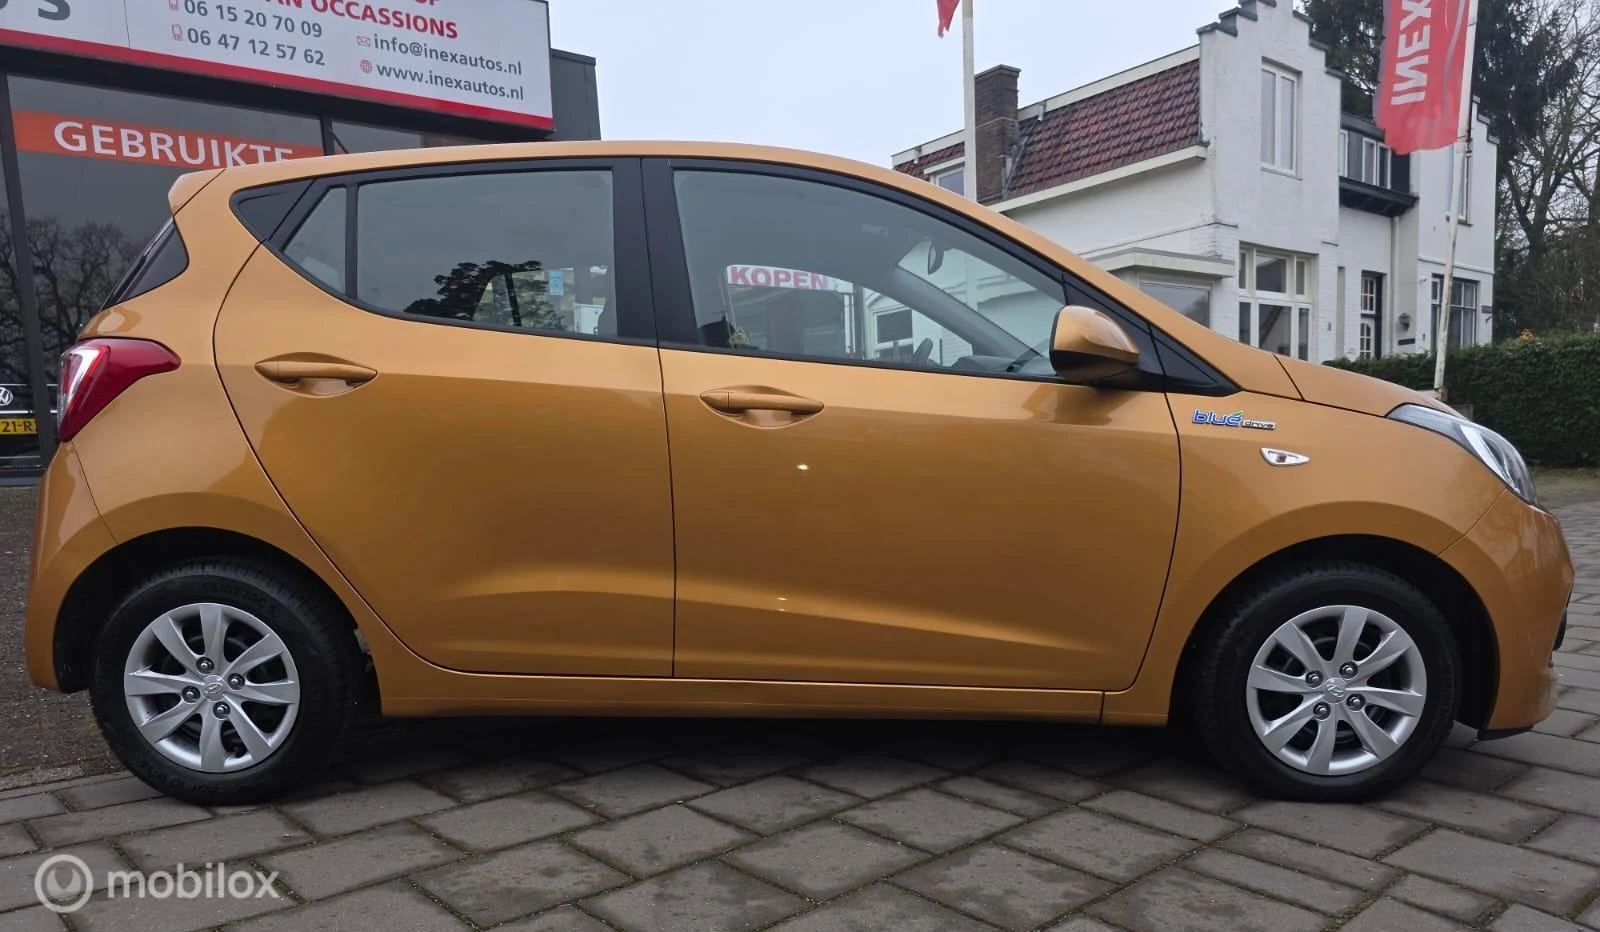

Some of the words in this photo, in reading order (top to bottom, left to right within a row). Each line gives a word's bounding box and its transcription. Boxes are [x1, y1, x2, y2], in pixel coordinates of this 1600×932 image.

[184, 0, 208, 17] 06
[216, 4, 238, 22] 15
[244, 9, 267, 27] 20
[272, 15, 295, 33] 70
[301, 20, 322, 38] 09
[311, 0, 458, 39] OCCASSIONS
[187, 28, 211, 46] 06
[217, 33, 240, 51] 47
[248, 39, 270, 57] 12
[276, 43, 297, 61] 57
[303, 48, 325, 66] 62
[374, 34, 522, 75] info@inexautos.nl
[1390, 0, 1432, 105] INEX
[376, 63, 524, 100] www.inexautos.nl
[730, 266, 829, 290] KOPEN
[0, 420, 37, 433] 21-R
[1243, 420, 1275, 430] drive
